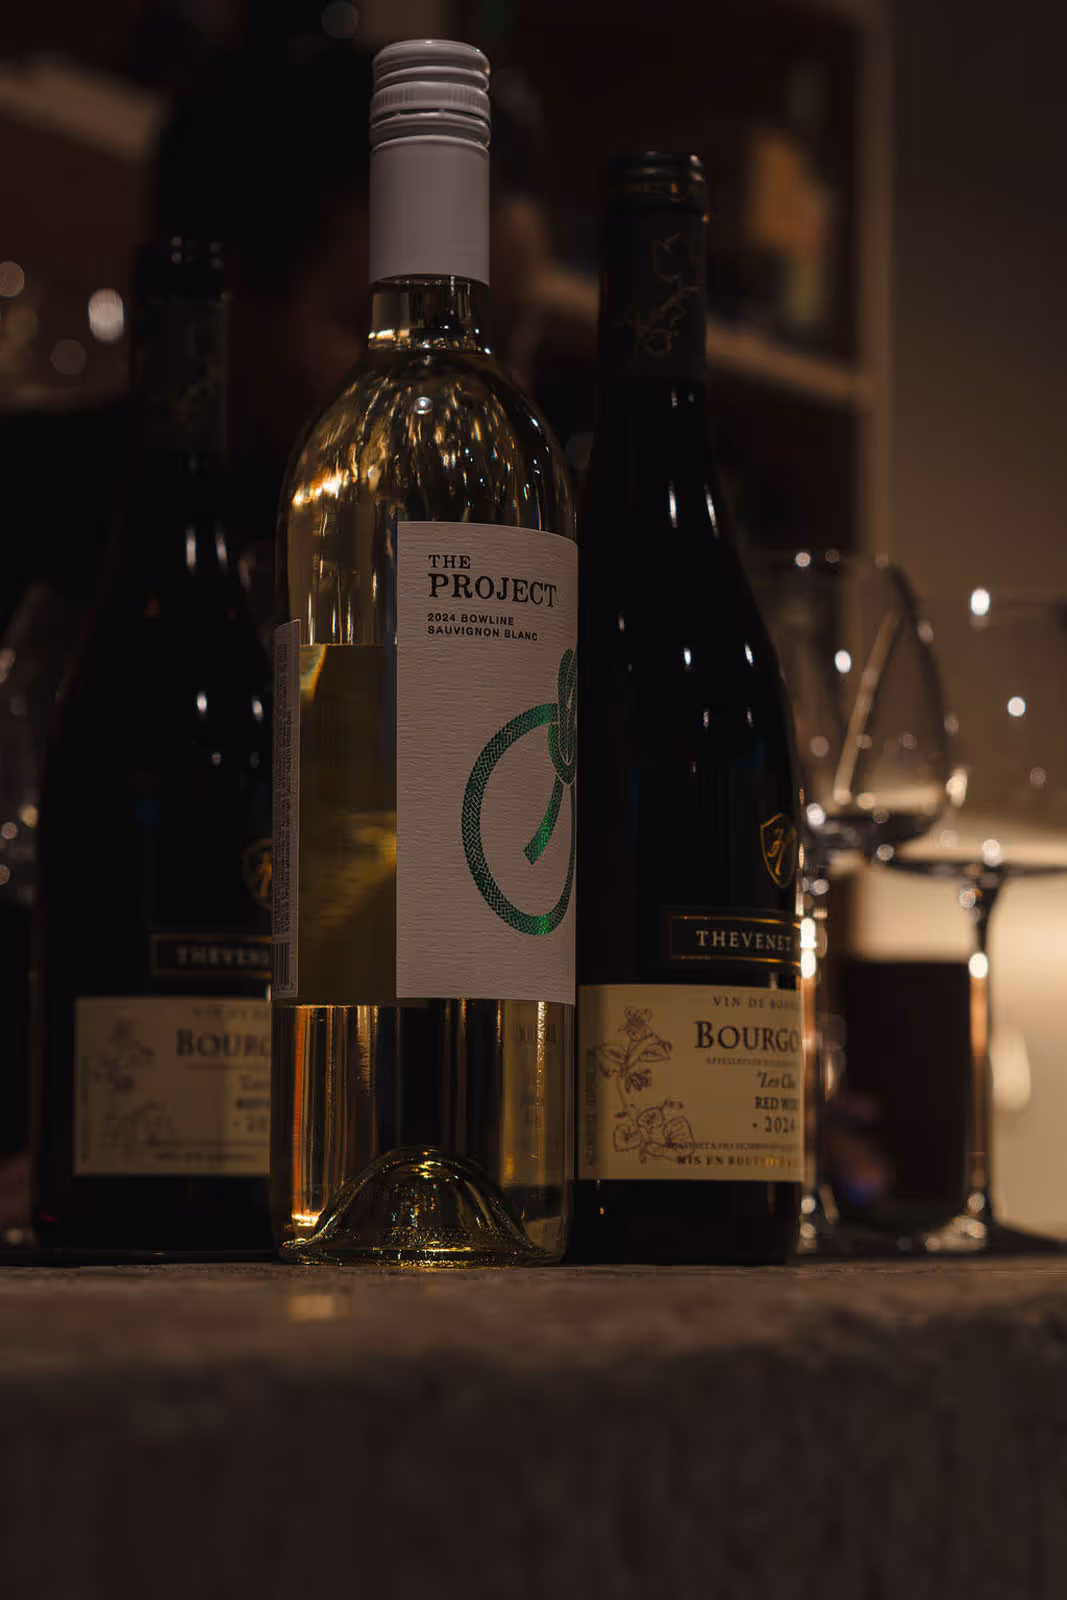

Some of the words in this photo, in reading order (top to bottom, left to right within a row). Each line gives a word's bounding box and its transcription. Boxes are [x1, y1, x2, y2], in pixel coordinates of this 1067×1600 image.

[428, 554, 471, 569] THE
[428, 573, 557, 607] PROJECT
[427, 612, 455, 622] 2024
[460, 614, 514, 626] BOWLINE
[427, 625, 500, 638] SAUVIGNON
[504, 629, 538, 641] BLANC
[695, 929, 793, 953] THEVENET
[712, 995, 740, 1008] VIN
